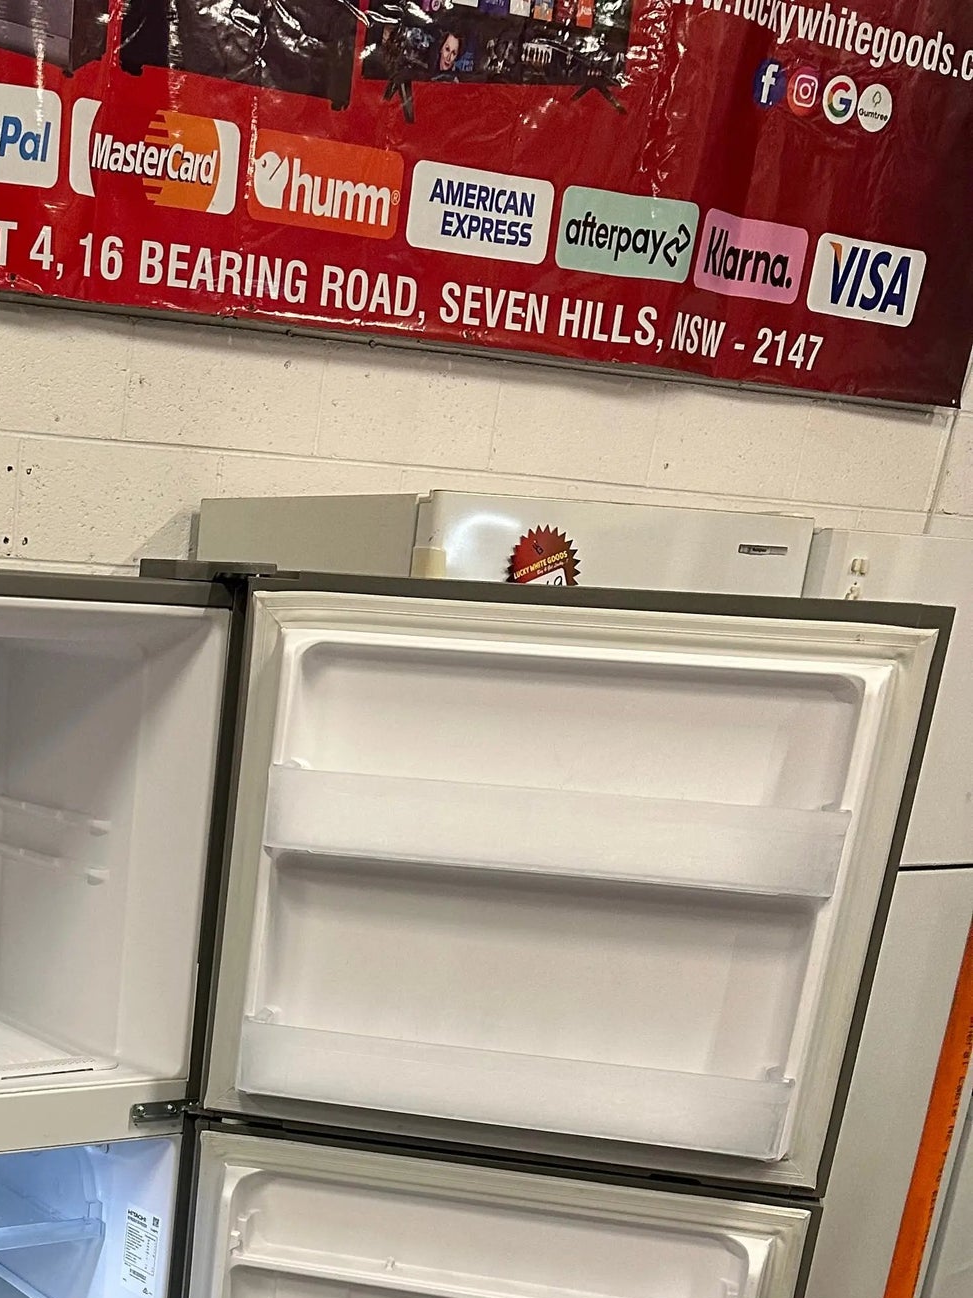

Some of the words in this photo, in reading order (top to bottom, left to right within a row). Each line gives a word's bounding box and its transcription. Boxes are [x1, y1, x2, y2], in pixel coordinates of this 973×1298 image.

[91, 133, 218, 186] MasterCard
[429, 178, 535, 219] AMERICAN
[441, 212, 532, 248] EXPRESS
[565, 212, 666, 264] afterpay
[704, 226, 793, 290] Klarna.
[830, 242, 912, 315] VISA
[29, 226, 64, 280] 4,
[79, 233, 124, 281] 16
[138, 240, 307, 304] BEARING
[320, 265, 426, 323] ROAD,
[440, 282, 549, 335] SEVEN
[558, 298, 663, 353] HILLS,
[671, 313, 726, 359] NSW
[752, 327, 824, 371] 2147
[514, 567, 530, 580] LUCKY
[530, 559, 547, 571] WHITE
[547, 551, 568, 563] GOODS
